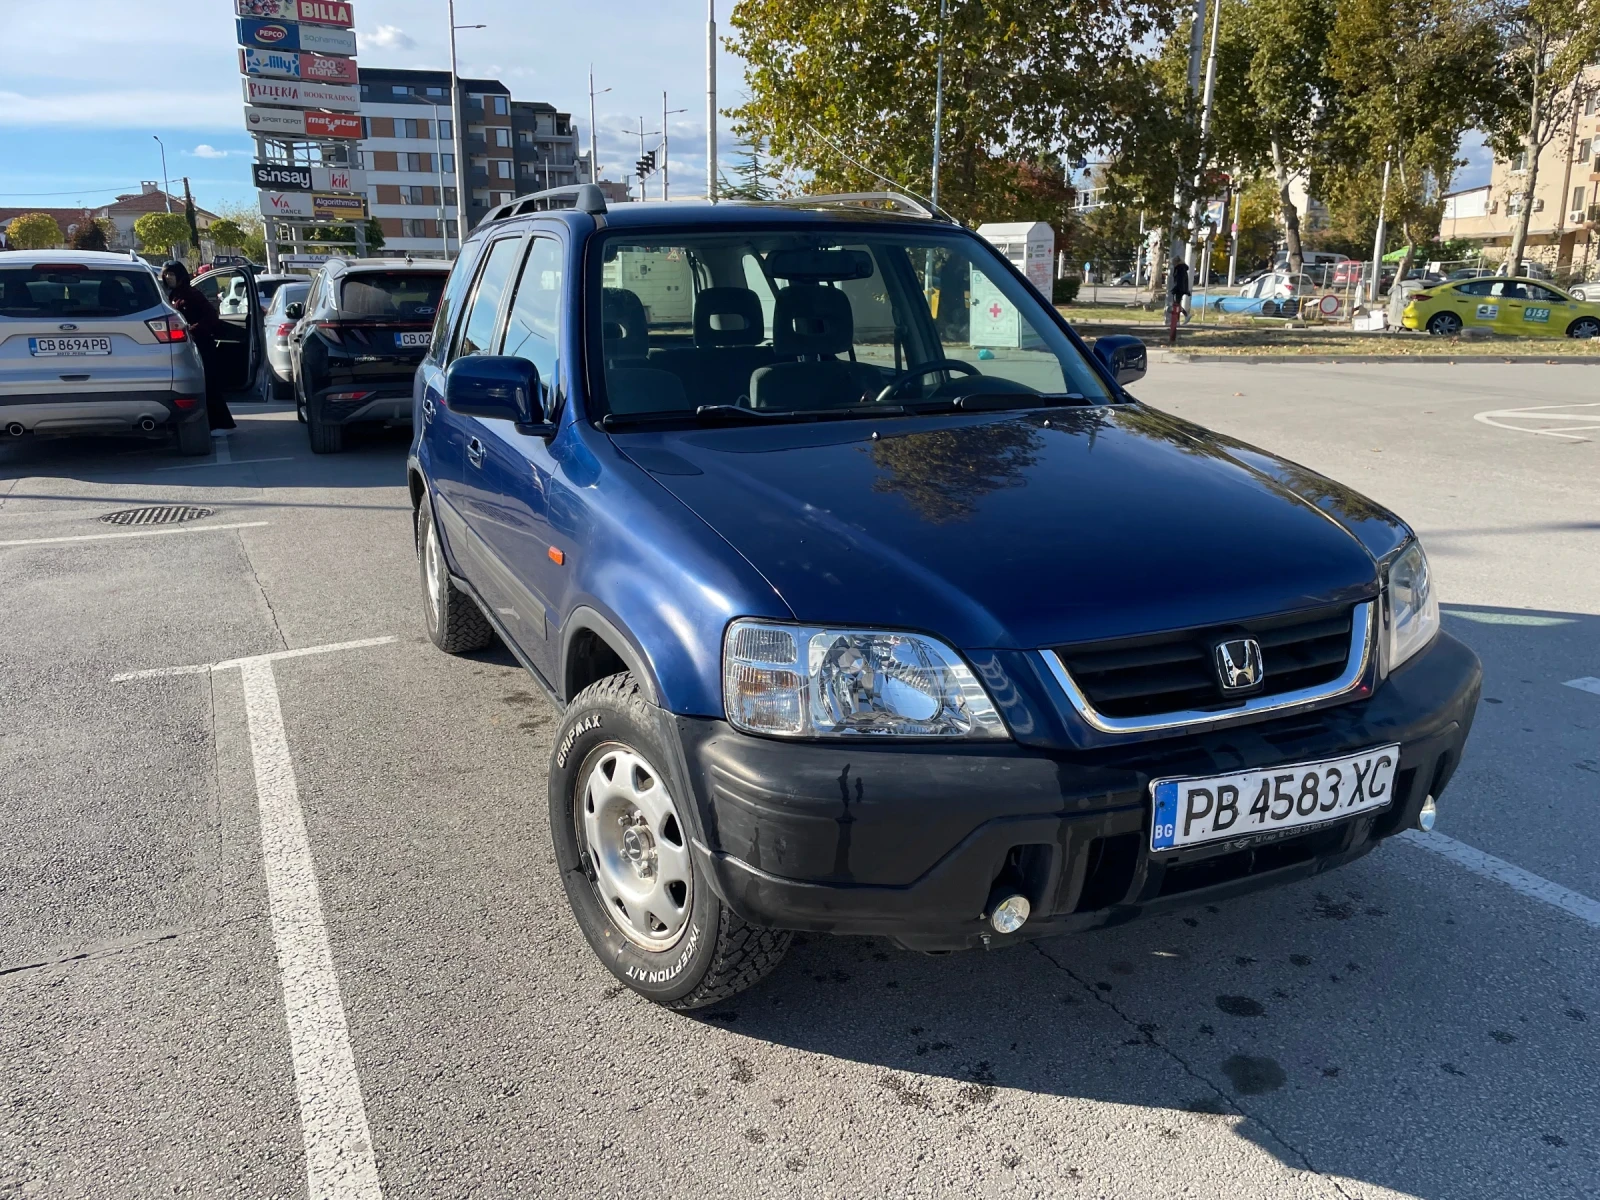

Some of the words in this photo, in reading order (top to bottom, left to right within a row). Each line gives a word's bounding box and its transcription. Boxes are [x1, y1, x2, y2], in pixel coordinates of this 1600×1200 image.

[301, 1, 349, 22] BILLA
[259, 29, 283, 38] PEPCO
[304, 34, 352, 47] sopharmacy
[268, 55, 292, 73] lilly
[313, 58, 336, 69] zoo
[307, 66, 339, 77] mania
[249, 83, 299, 100] PIZZERIA
[303, 91, 356, 102] BOOKTRADING
[308, 116, 332, 125] mat
[334, 118, 359, 127] star
[258, 166, 310, 188] sinsay
[331, 172, 349, 189] kik
[270, 194, 289, 208] VIA
[316, 198, 359, 207] Algorithmics
[1525, 307, 1548, 318] 6155
[39, 340, 56, 351] CB
[58, 339, 89, 351] 8694
[91, 339, 108, 350] PB
[402, 334, 416, 345] CB
[556, 714, 602, 769] GRIPMAX
[1183, 784, 1240, 837] PB
[1248, 767, 1343, 824] 4583
[1346, 755, 1392, 808] XC
[1155, 823, 1174, 840] BG
[648, 922, 701, 983] INCEPTION
[625, 965, 648, 981] A/T
